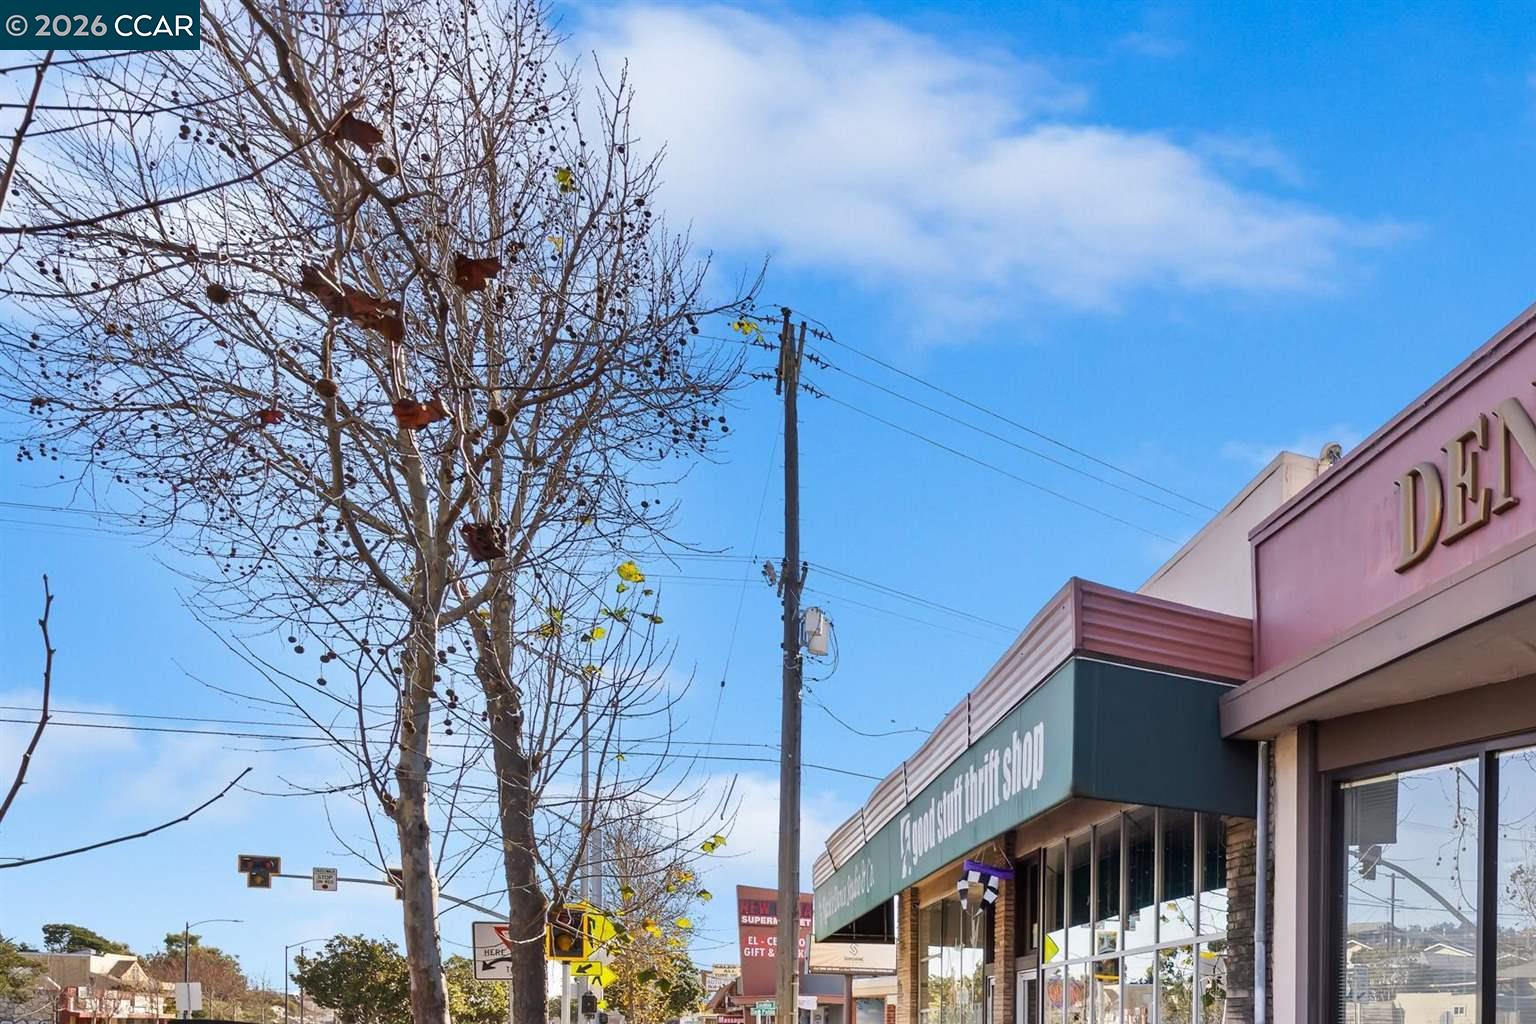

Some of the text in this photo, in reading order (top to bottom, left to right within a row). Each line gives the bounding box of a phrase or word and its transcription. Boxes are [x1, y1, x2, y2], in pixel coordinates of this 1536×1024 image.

[912, 721, 1045, 865] good stuff thrift shop
[741, 915, 812, 927] SUPERMET
[748, 936, 759, 945] EL
[743, 947, 766, 957] GIFT
[767, 948, 775, 957] &
